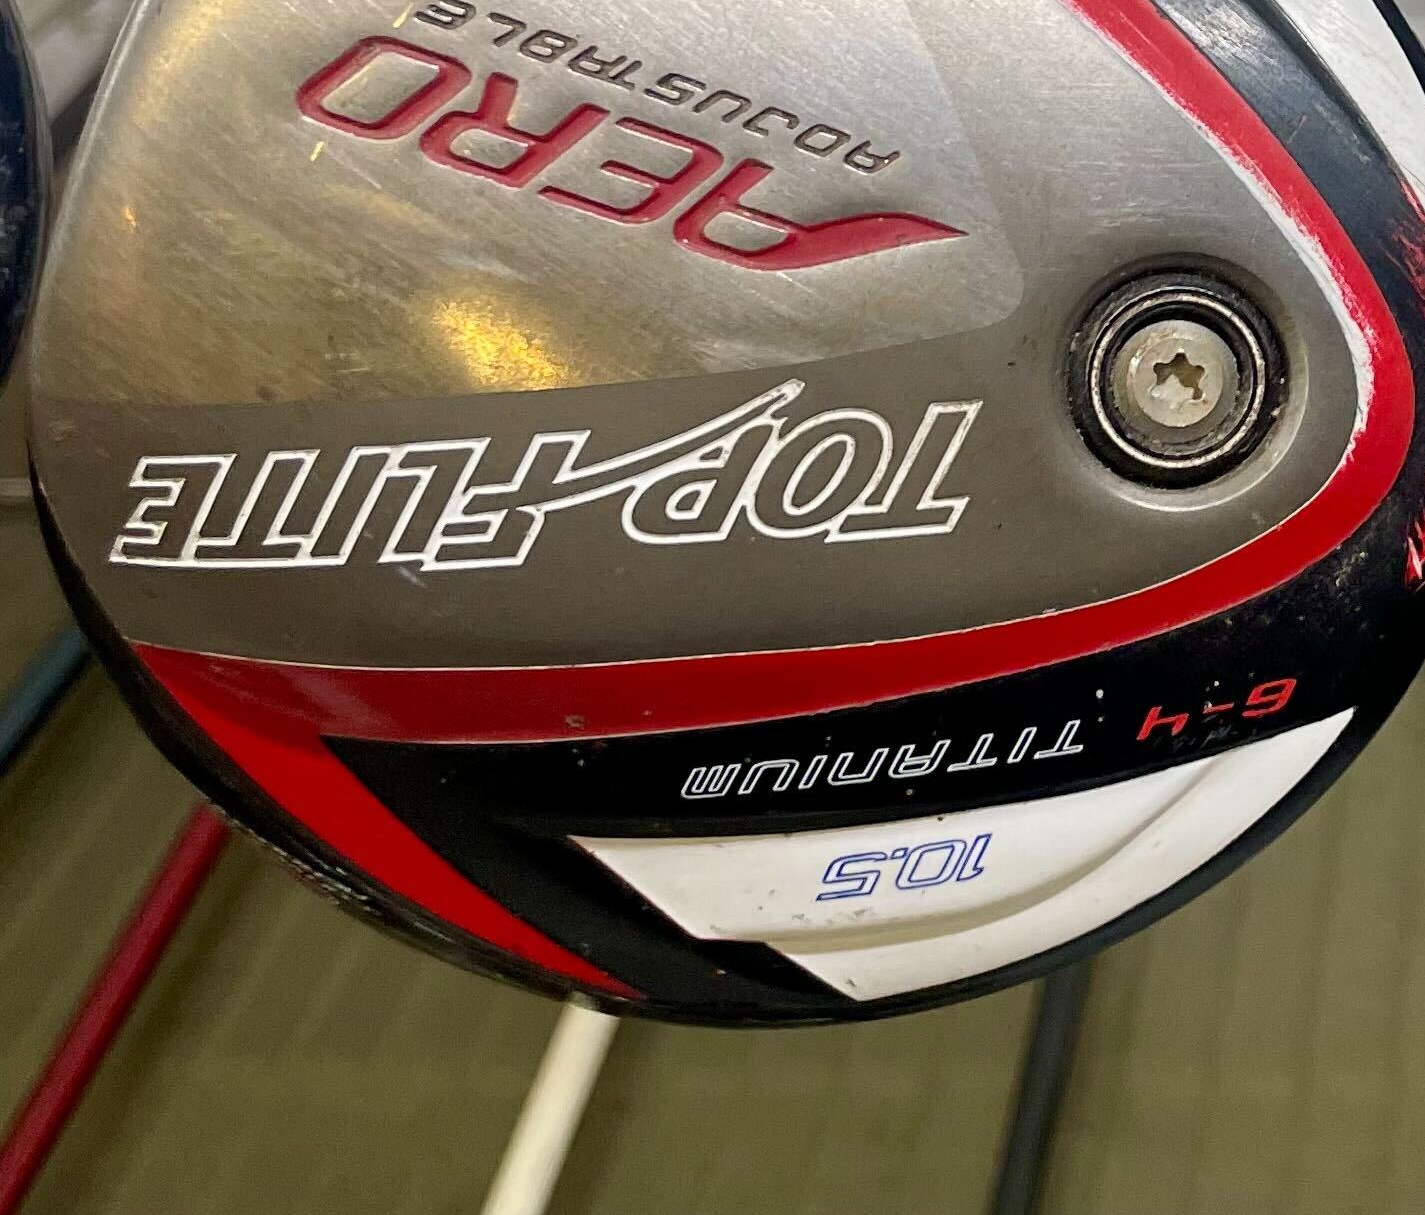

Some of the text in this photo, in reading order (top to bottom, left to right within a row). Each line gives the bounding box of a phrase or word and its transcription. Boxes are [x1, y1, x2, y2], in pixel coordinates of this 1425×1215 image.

[294, 35, 970, 273] AERO
[109, 428, 592, 572] FLITE
[680, 677, 1298, 800] 6-4 TITANIUM
[815, 831, 994, 903] 10.5
